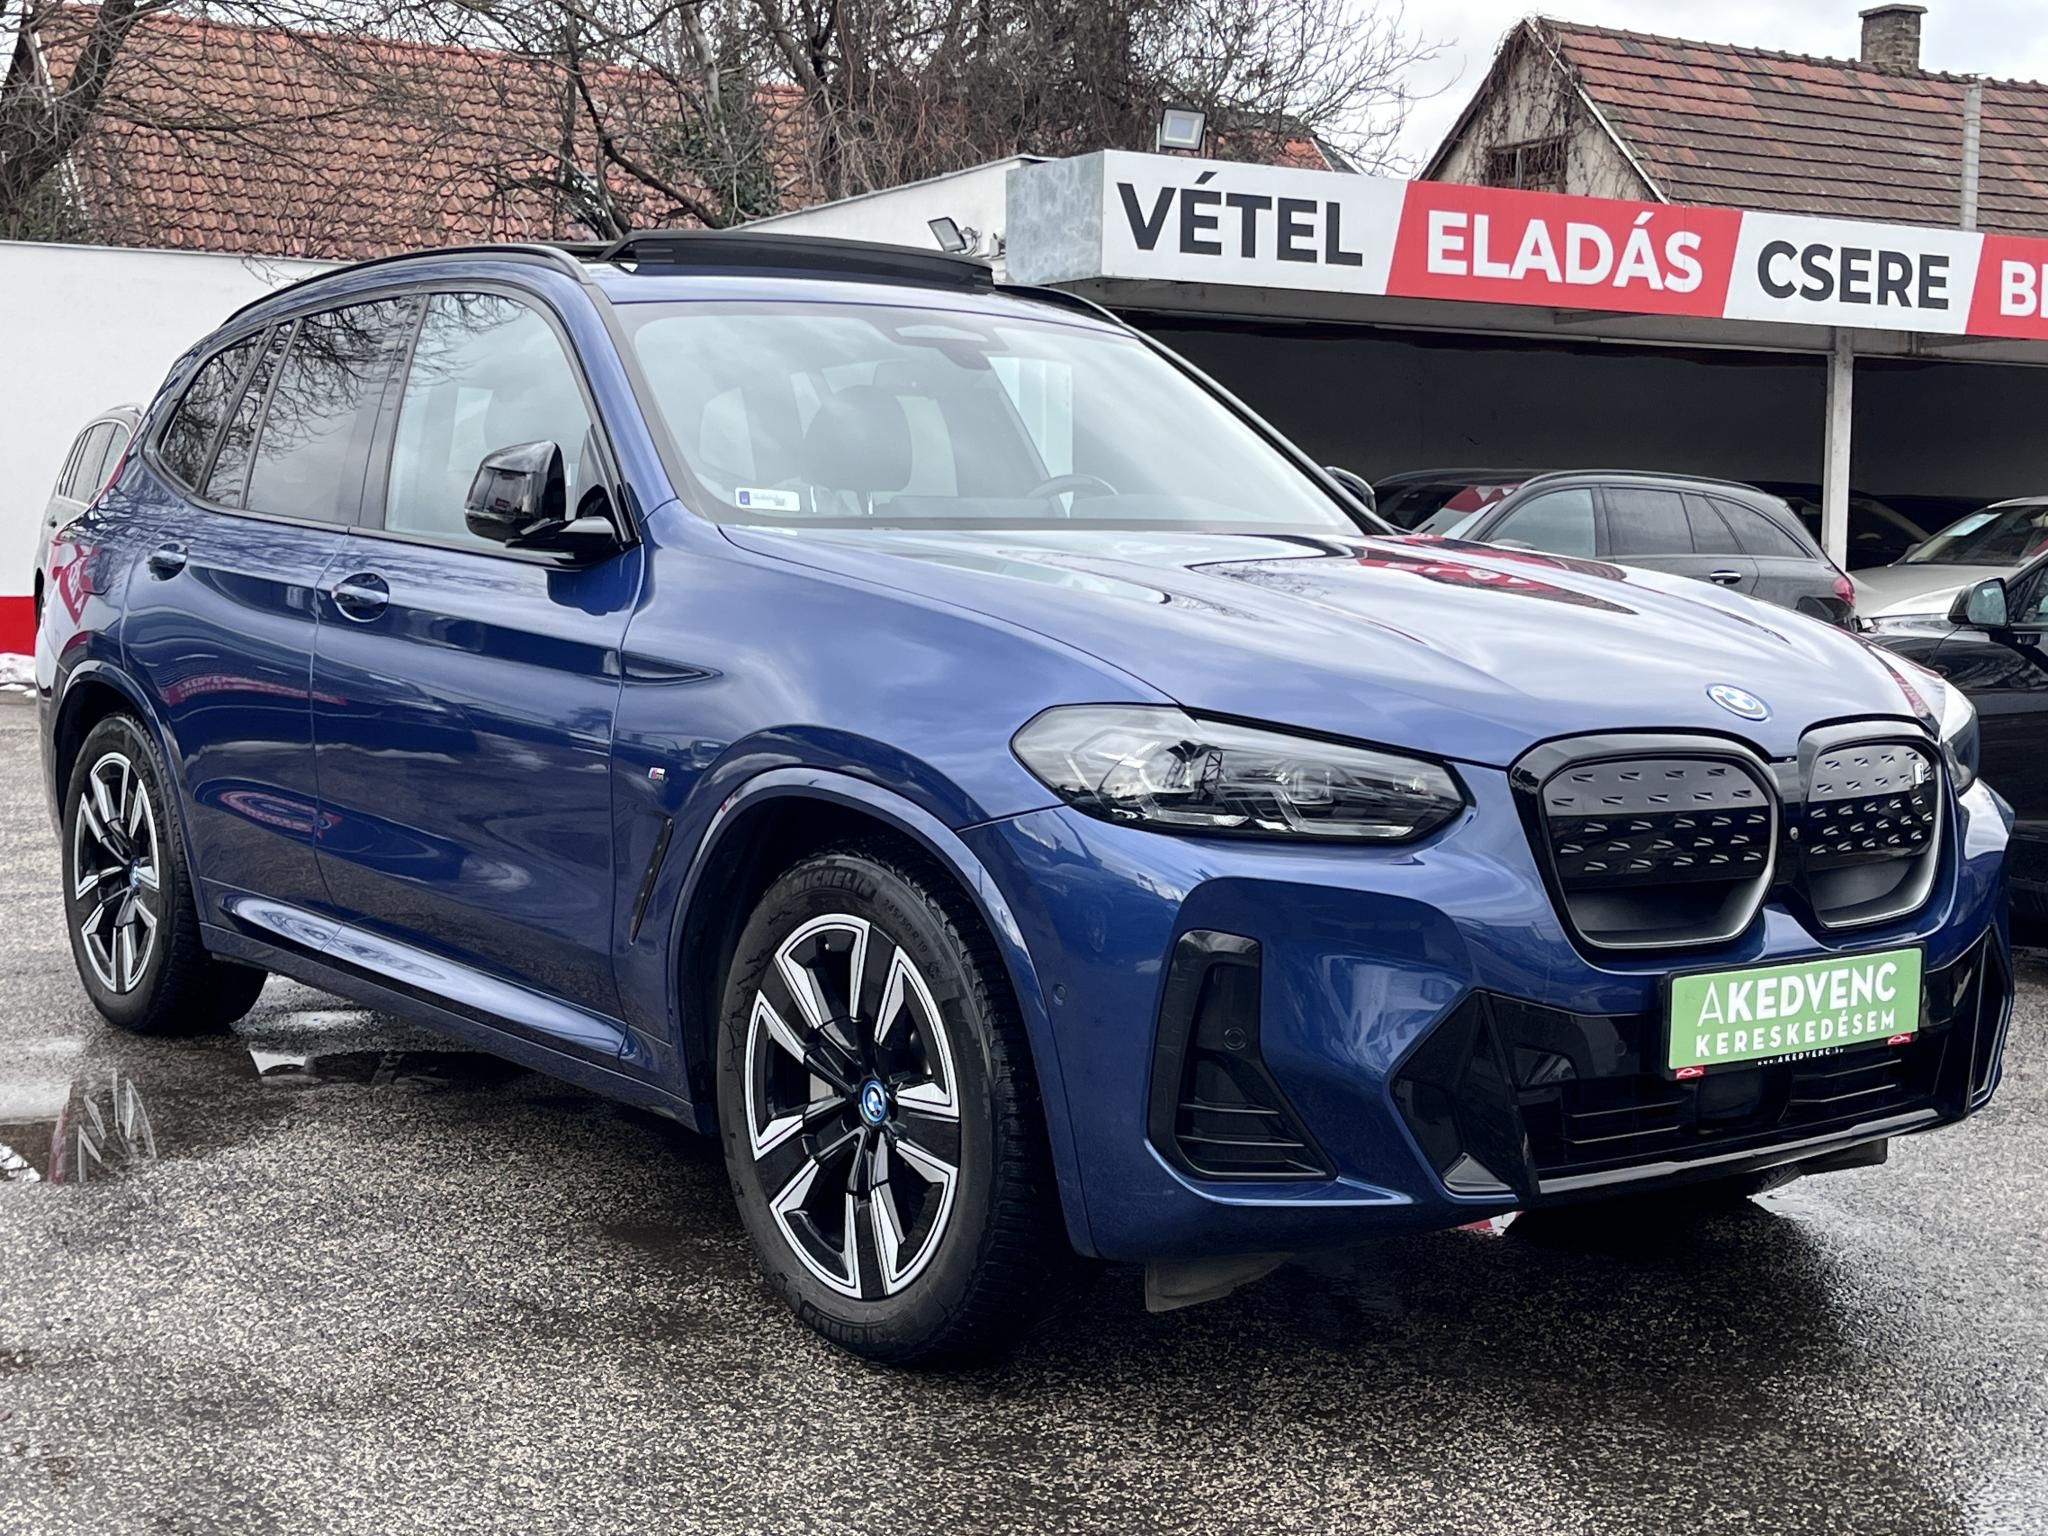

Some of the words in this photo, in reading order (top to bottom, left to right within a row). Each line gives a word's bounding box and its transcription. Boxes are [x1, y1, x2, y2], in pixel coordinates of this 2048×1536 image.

[1116, 171, 1363, 267] VÉTEL
[1427, 213, 1702, 293] ELADÁS
[1758, 239, 1950, 310] CSERE
[1695, 1008, 1895, 1057] KERESKEDÉSEM
